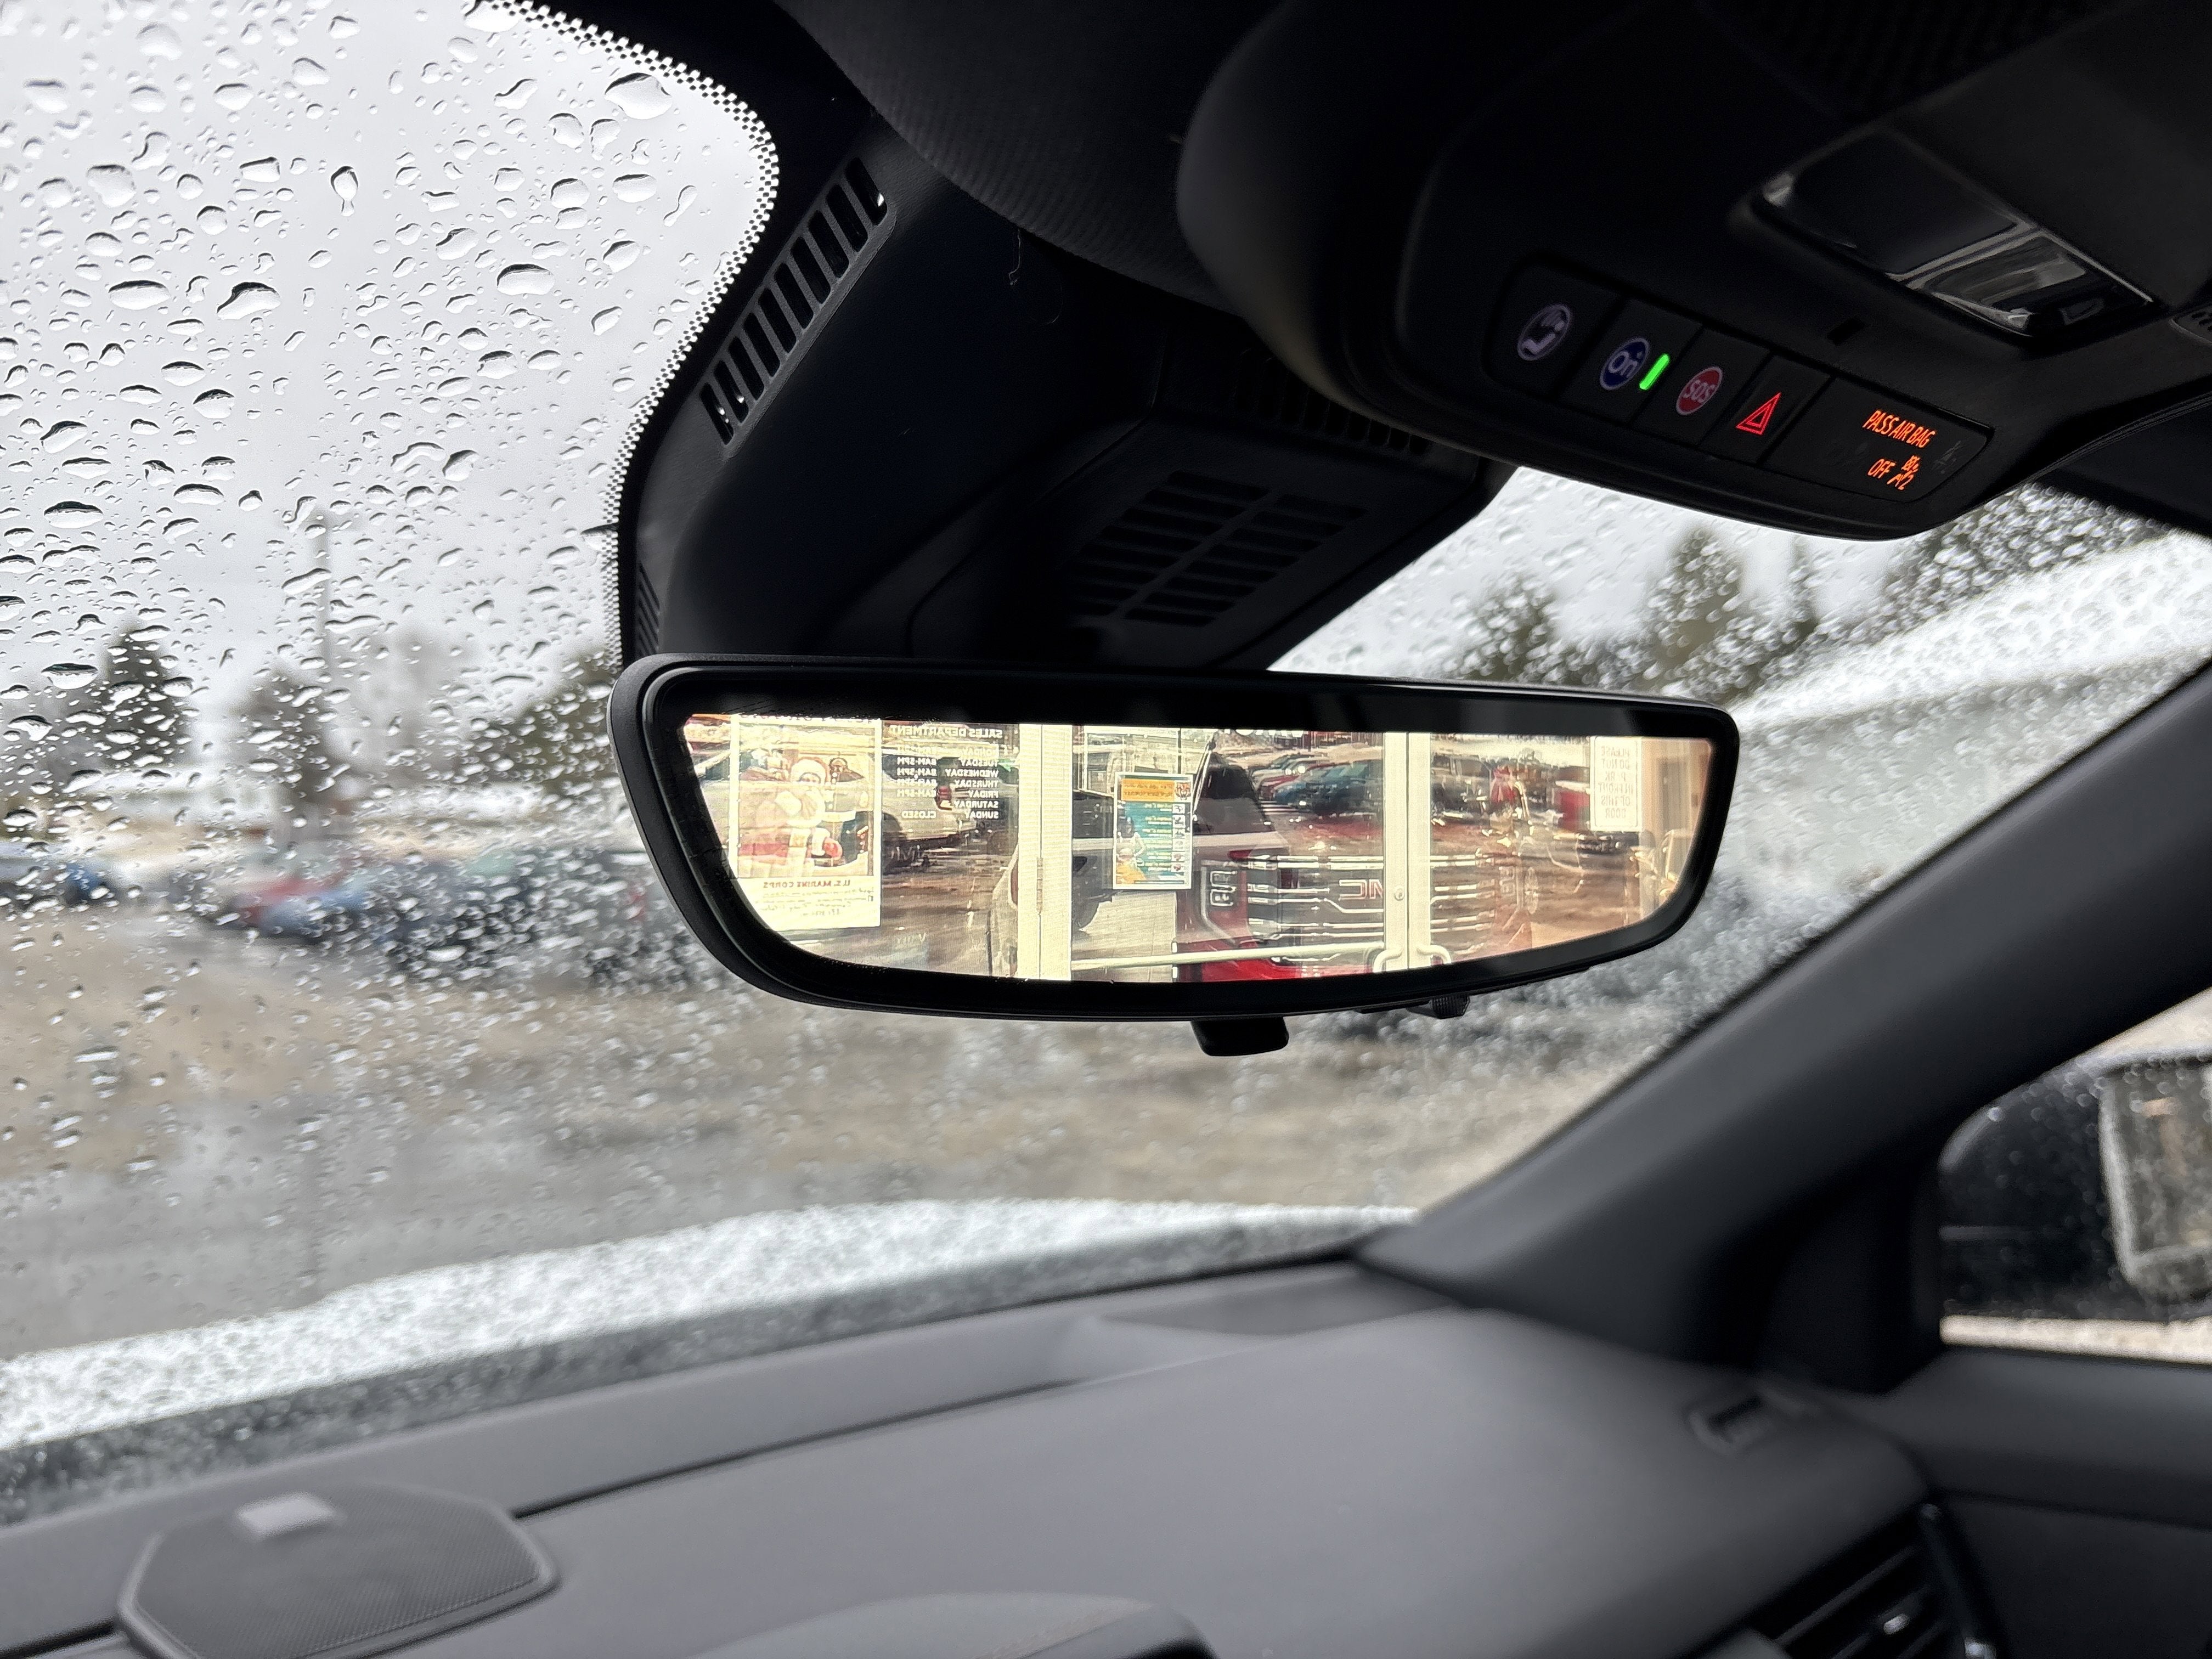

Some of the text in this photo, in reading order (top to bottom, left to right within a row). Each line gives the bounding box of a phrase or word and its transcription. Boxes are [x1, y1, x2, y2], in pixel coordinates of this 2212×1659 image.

[1680, 379, 1716, 403] SOS
[1862, 410, 1900, 436] PASS
[1867, 458, 1897, 479] OFF
